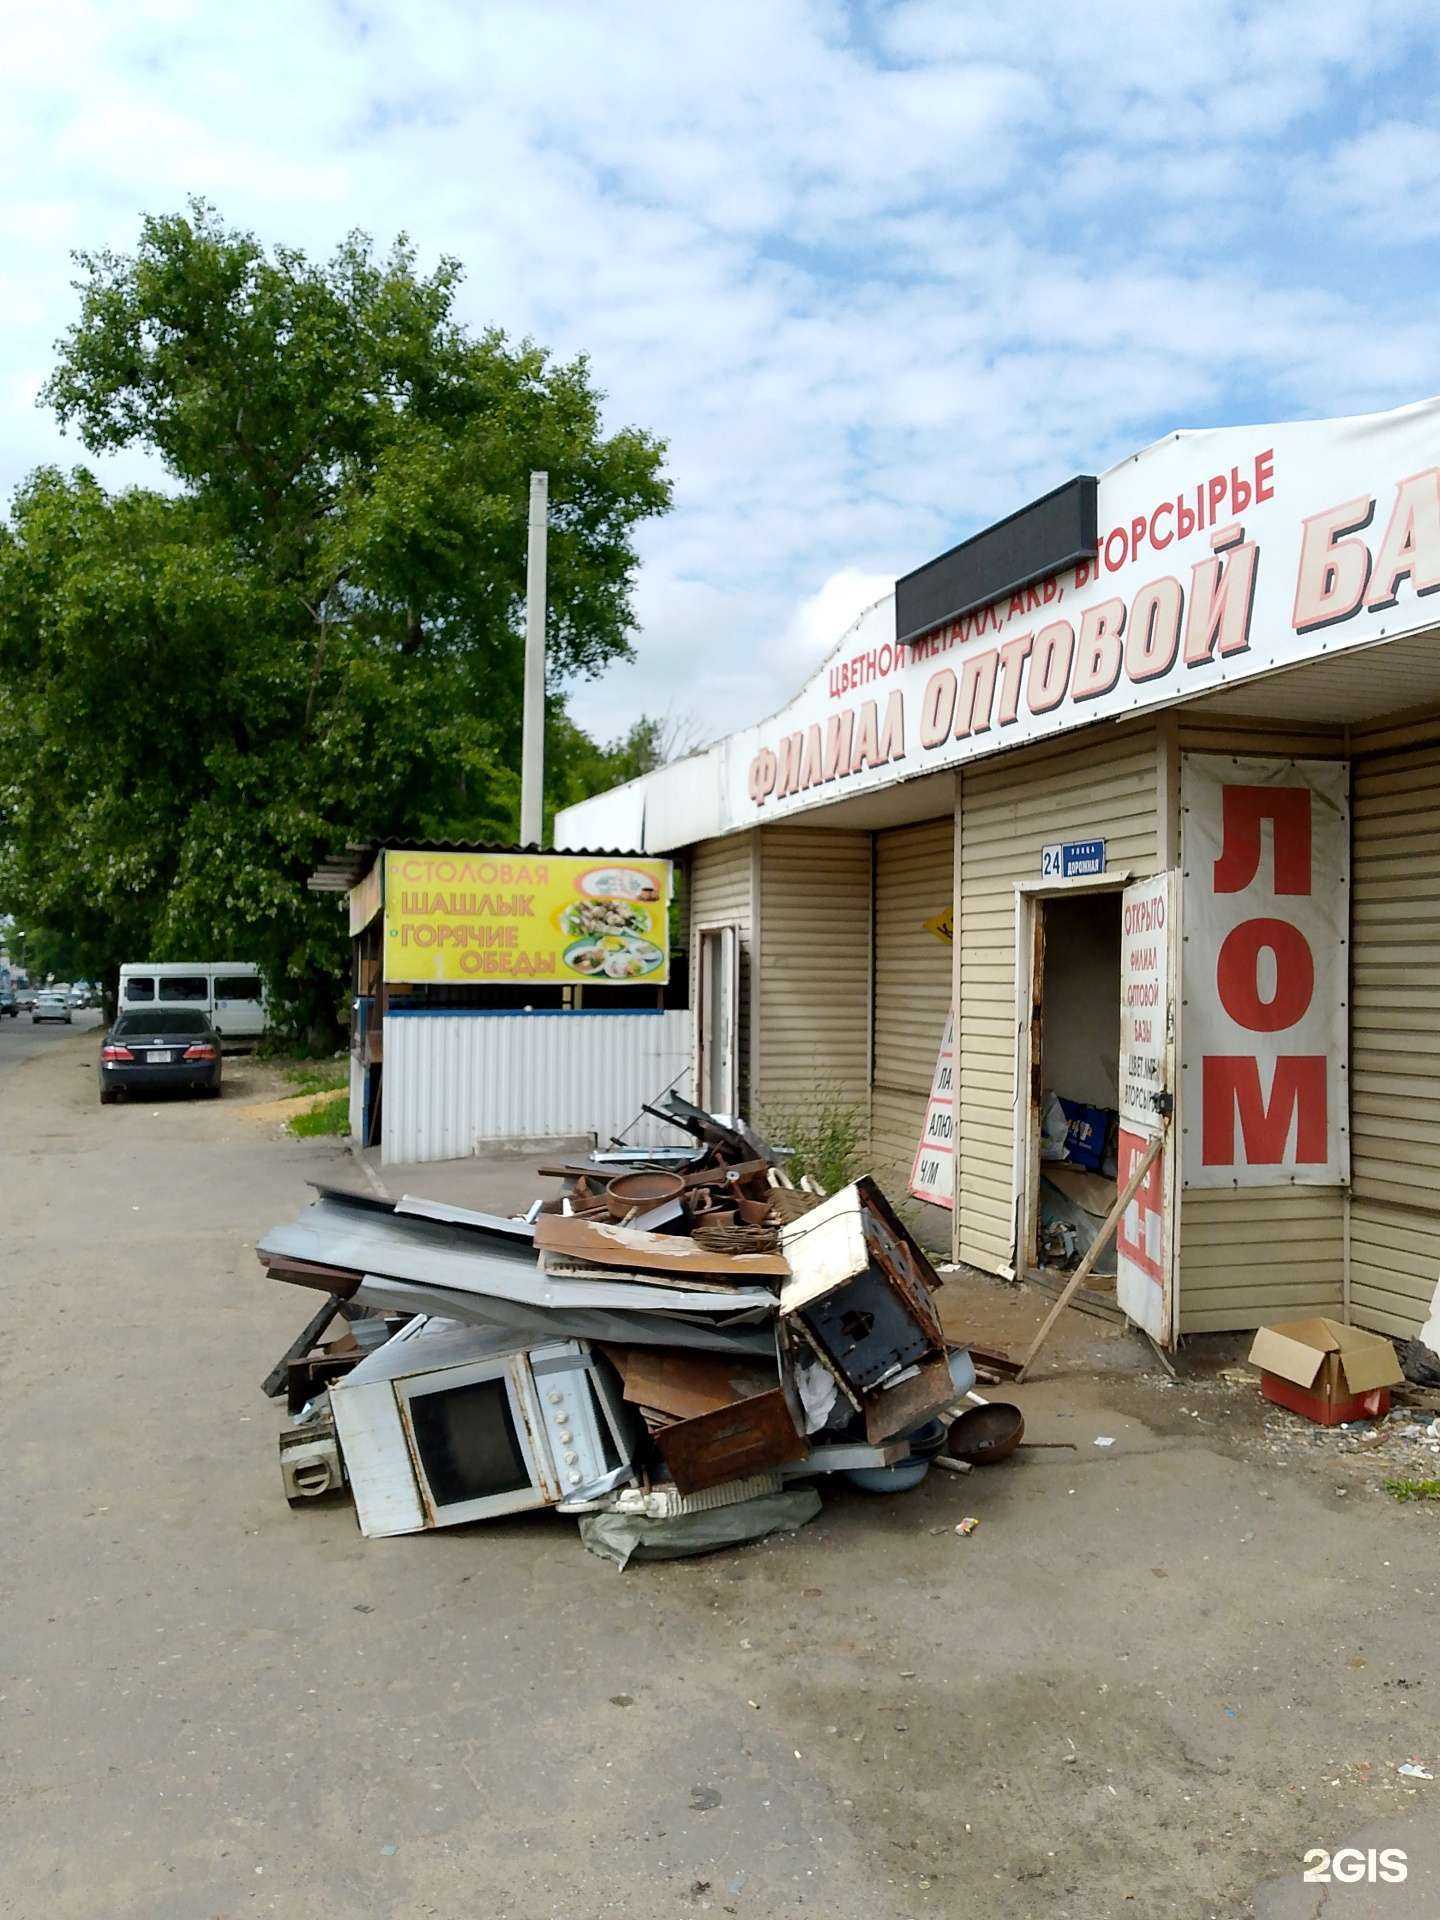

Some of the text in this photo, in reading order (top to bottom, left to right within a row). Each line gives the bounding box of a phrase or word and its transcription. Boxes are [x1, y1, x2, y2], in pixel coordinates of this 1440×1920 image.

[749, 688, 906, 807] ФИЛИАЛ
[919, 522, 1260, 751] ОПТОВОЙ
[828, 641, 905, 698] ЦВЕТНОЙ
[402, 860, 549, 886] СТОЛОВАЯ
[1043, 851, 1061, 875] 24
[1067, 858, 1100, 876] ДОРОЖНАЯ
[401, 892, 535, 917] ШАШЛЫК
[1124, 895, 1165, 937] ОТКРЫТО
[401, 924, 519, 949] ГОРЯЧИЕ
[459, 950, 556, 977] ОБЕДЫ
[1130, 947, 1158, 972] ФИЛИАЛ
[1203, 785, 1328, 1166] ЛОМ
[1127, 977, 1159, 1007] ОПТОВОЙ
[1134, 1018, 1152, 1043] БАЗЫ
[928, 1112, 954, 1139] АЛЮ
[919, 1159, 940, 1185] Ч/М
